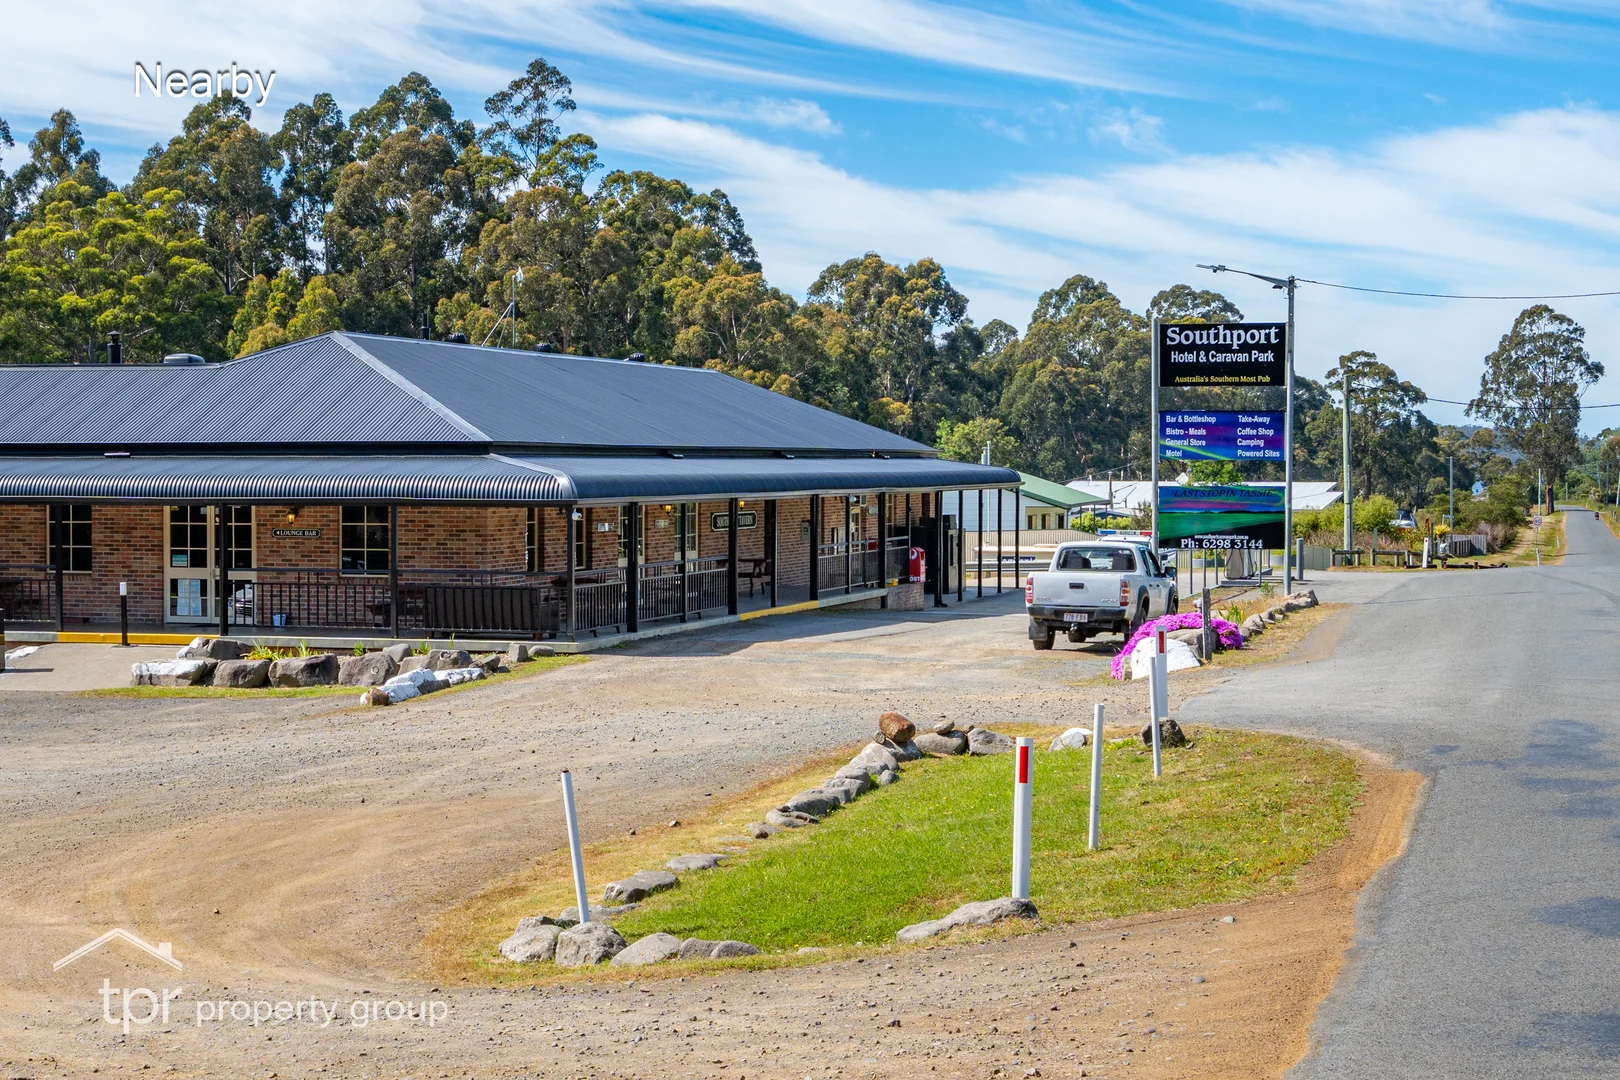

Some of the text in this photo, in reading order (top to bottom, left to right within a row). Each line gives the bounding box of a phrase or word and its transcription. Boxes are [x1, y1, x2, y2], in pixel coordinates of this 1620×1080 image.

[1166, 325, 1280, 350] Southport
[1171, 350, 1275, 363] Hotel & Caravan Park
[1174, 375, 1271, 383] Australia's Southern Most Pub
[1165, 415, 1217, 424] Bar & Bottleshop
[1237, 415, 1271, 424] Take-Away
[1165, 427, 1184, 436] Bistro
[1188, 427, 1207, 436] Meals
[1237, 427, 1274, 437] Coffee Shop
[1165, 438, 1206, 446] General Store
[1237, 438, 1265, 447] Camping
[1165, 449, 1183, 457] Motel
[1237, 449, 1280, 457] Powered Sites
[1201, 489, 1225, 497] STOP
[1225, 489, 1237, 497] IN
[1180, 538, 1264, 549] Ph: 6298 3144
